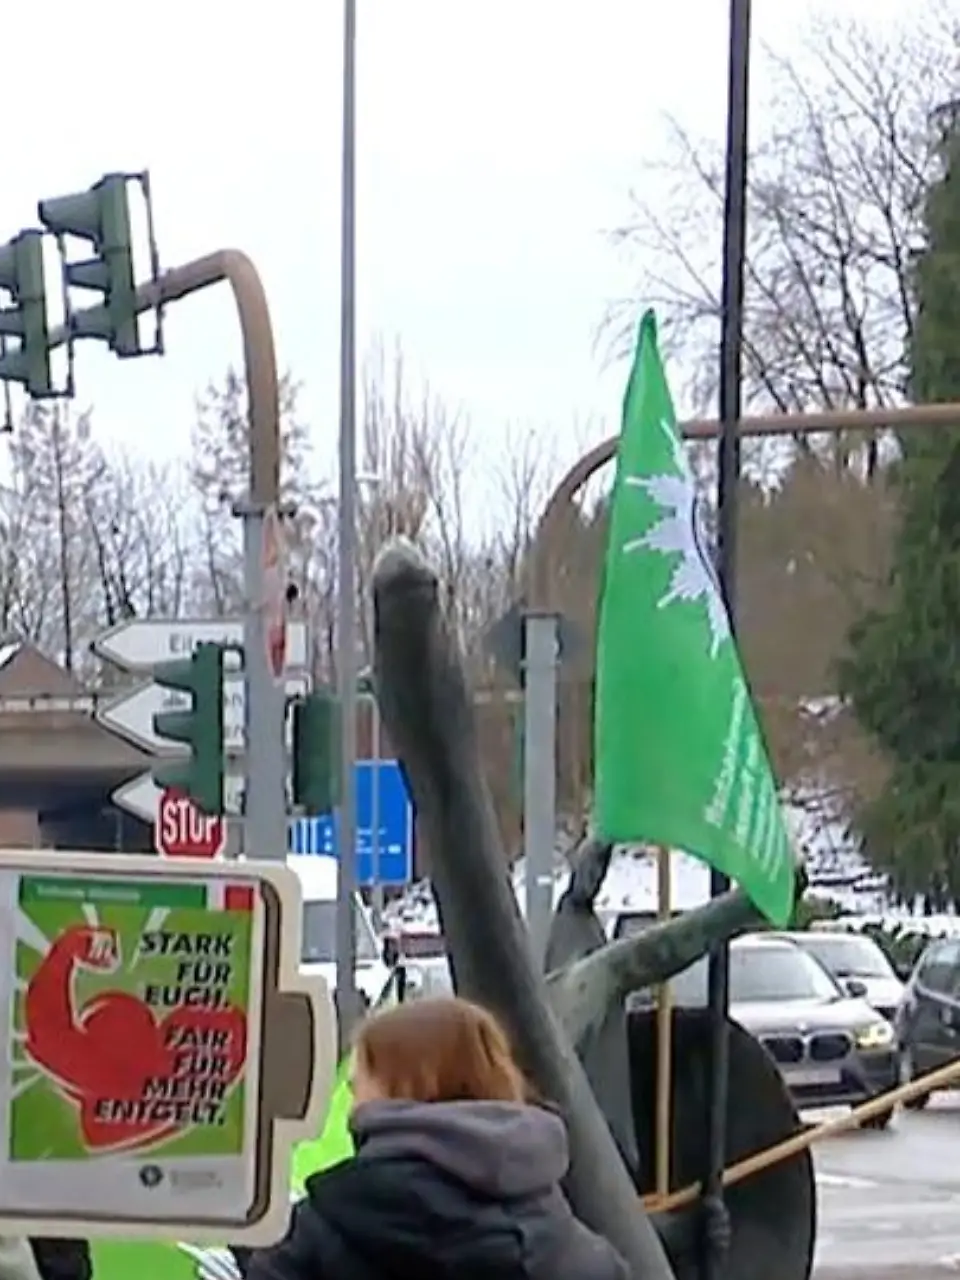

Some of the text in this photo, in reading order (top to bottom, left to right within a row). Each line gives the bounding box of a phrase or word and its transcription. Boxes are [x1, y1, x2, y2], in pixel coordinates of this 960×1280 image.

[162, 799, 219, 844] STOP
[141, 930, 233, 956] STARK
[164, 1025, 230, 1049] FAIR
